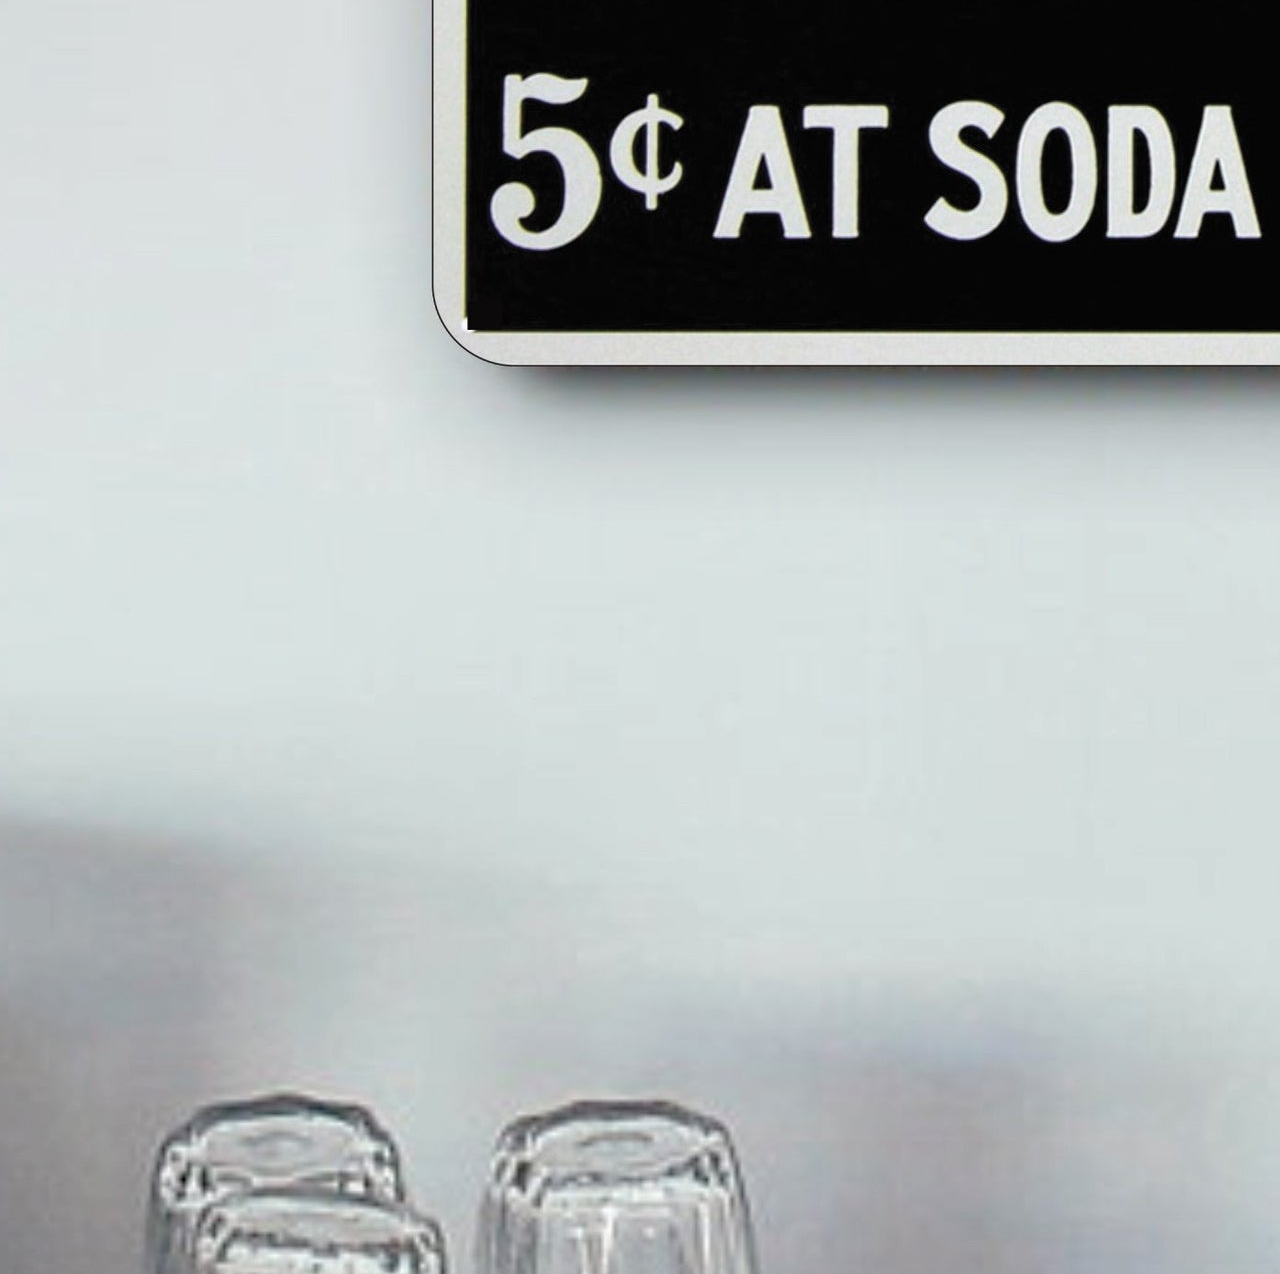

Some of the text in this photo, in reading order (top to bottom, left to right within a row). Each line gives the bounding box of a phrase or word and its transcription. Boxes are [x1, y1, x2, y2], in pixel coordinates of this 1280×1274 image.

[489, 72, 685, 251] 5¢
[712, 104, 890, 240] AT
[923, 100, 1262, 243] SODA
